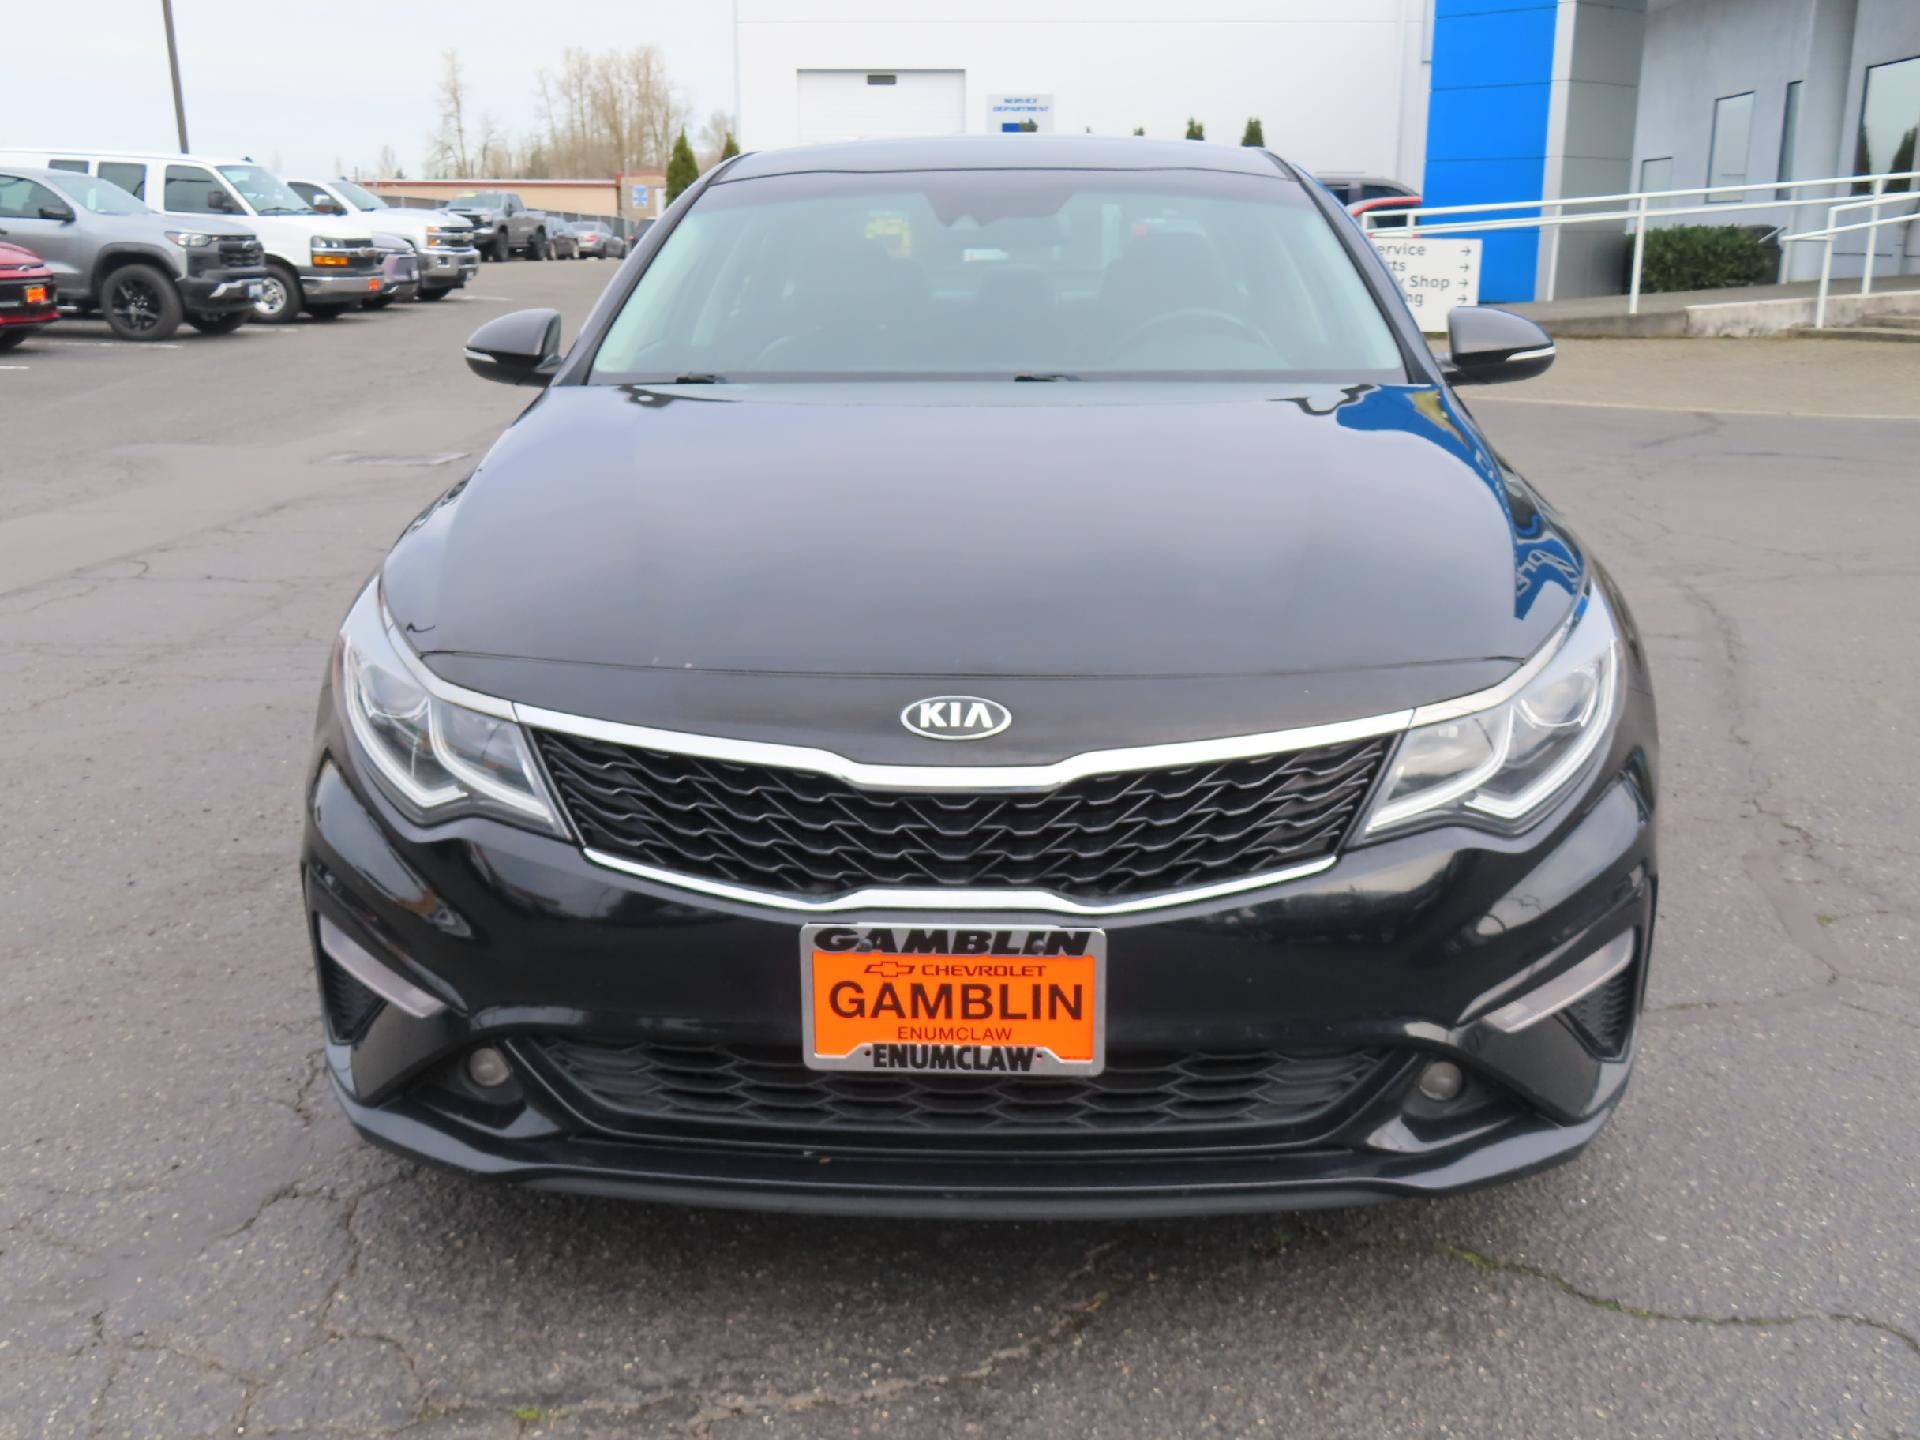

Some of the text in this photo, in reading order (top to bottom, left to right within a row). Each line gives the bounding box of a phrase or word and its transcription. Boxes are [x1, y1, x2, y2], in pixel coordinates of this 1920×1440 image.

[1377, 243, 1426, 256] ervice
[1409, 275, 1450, 291] Shop
[920, 702, 993, 728] KIA
[814, 927, 1092, 956] GAMBLIN
[921, 964, 1047, 977] CHEVROLET
[829, 980, 1083, 1020] GAMBLIN
[897, 1026, 1013, 1041] ENUMCLAW
[873, 1044, 1035, 1072] ENUMCLAW
